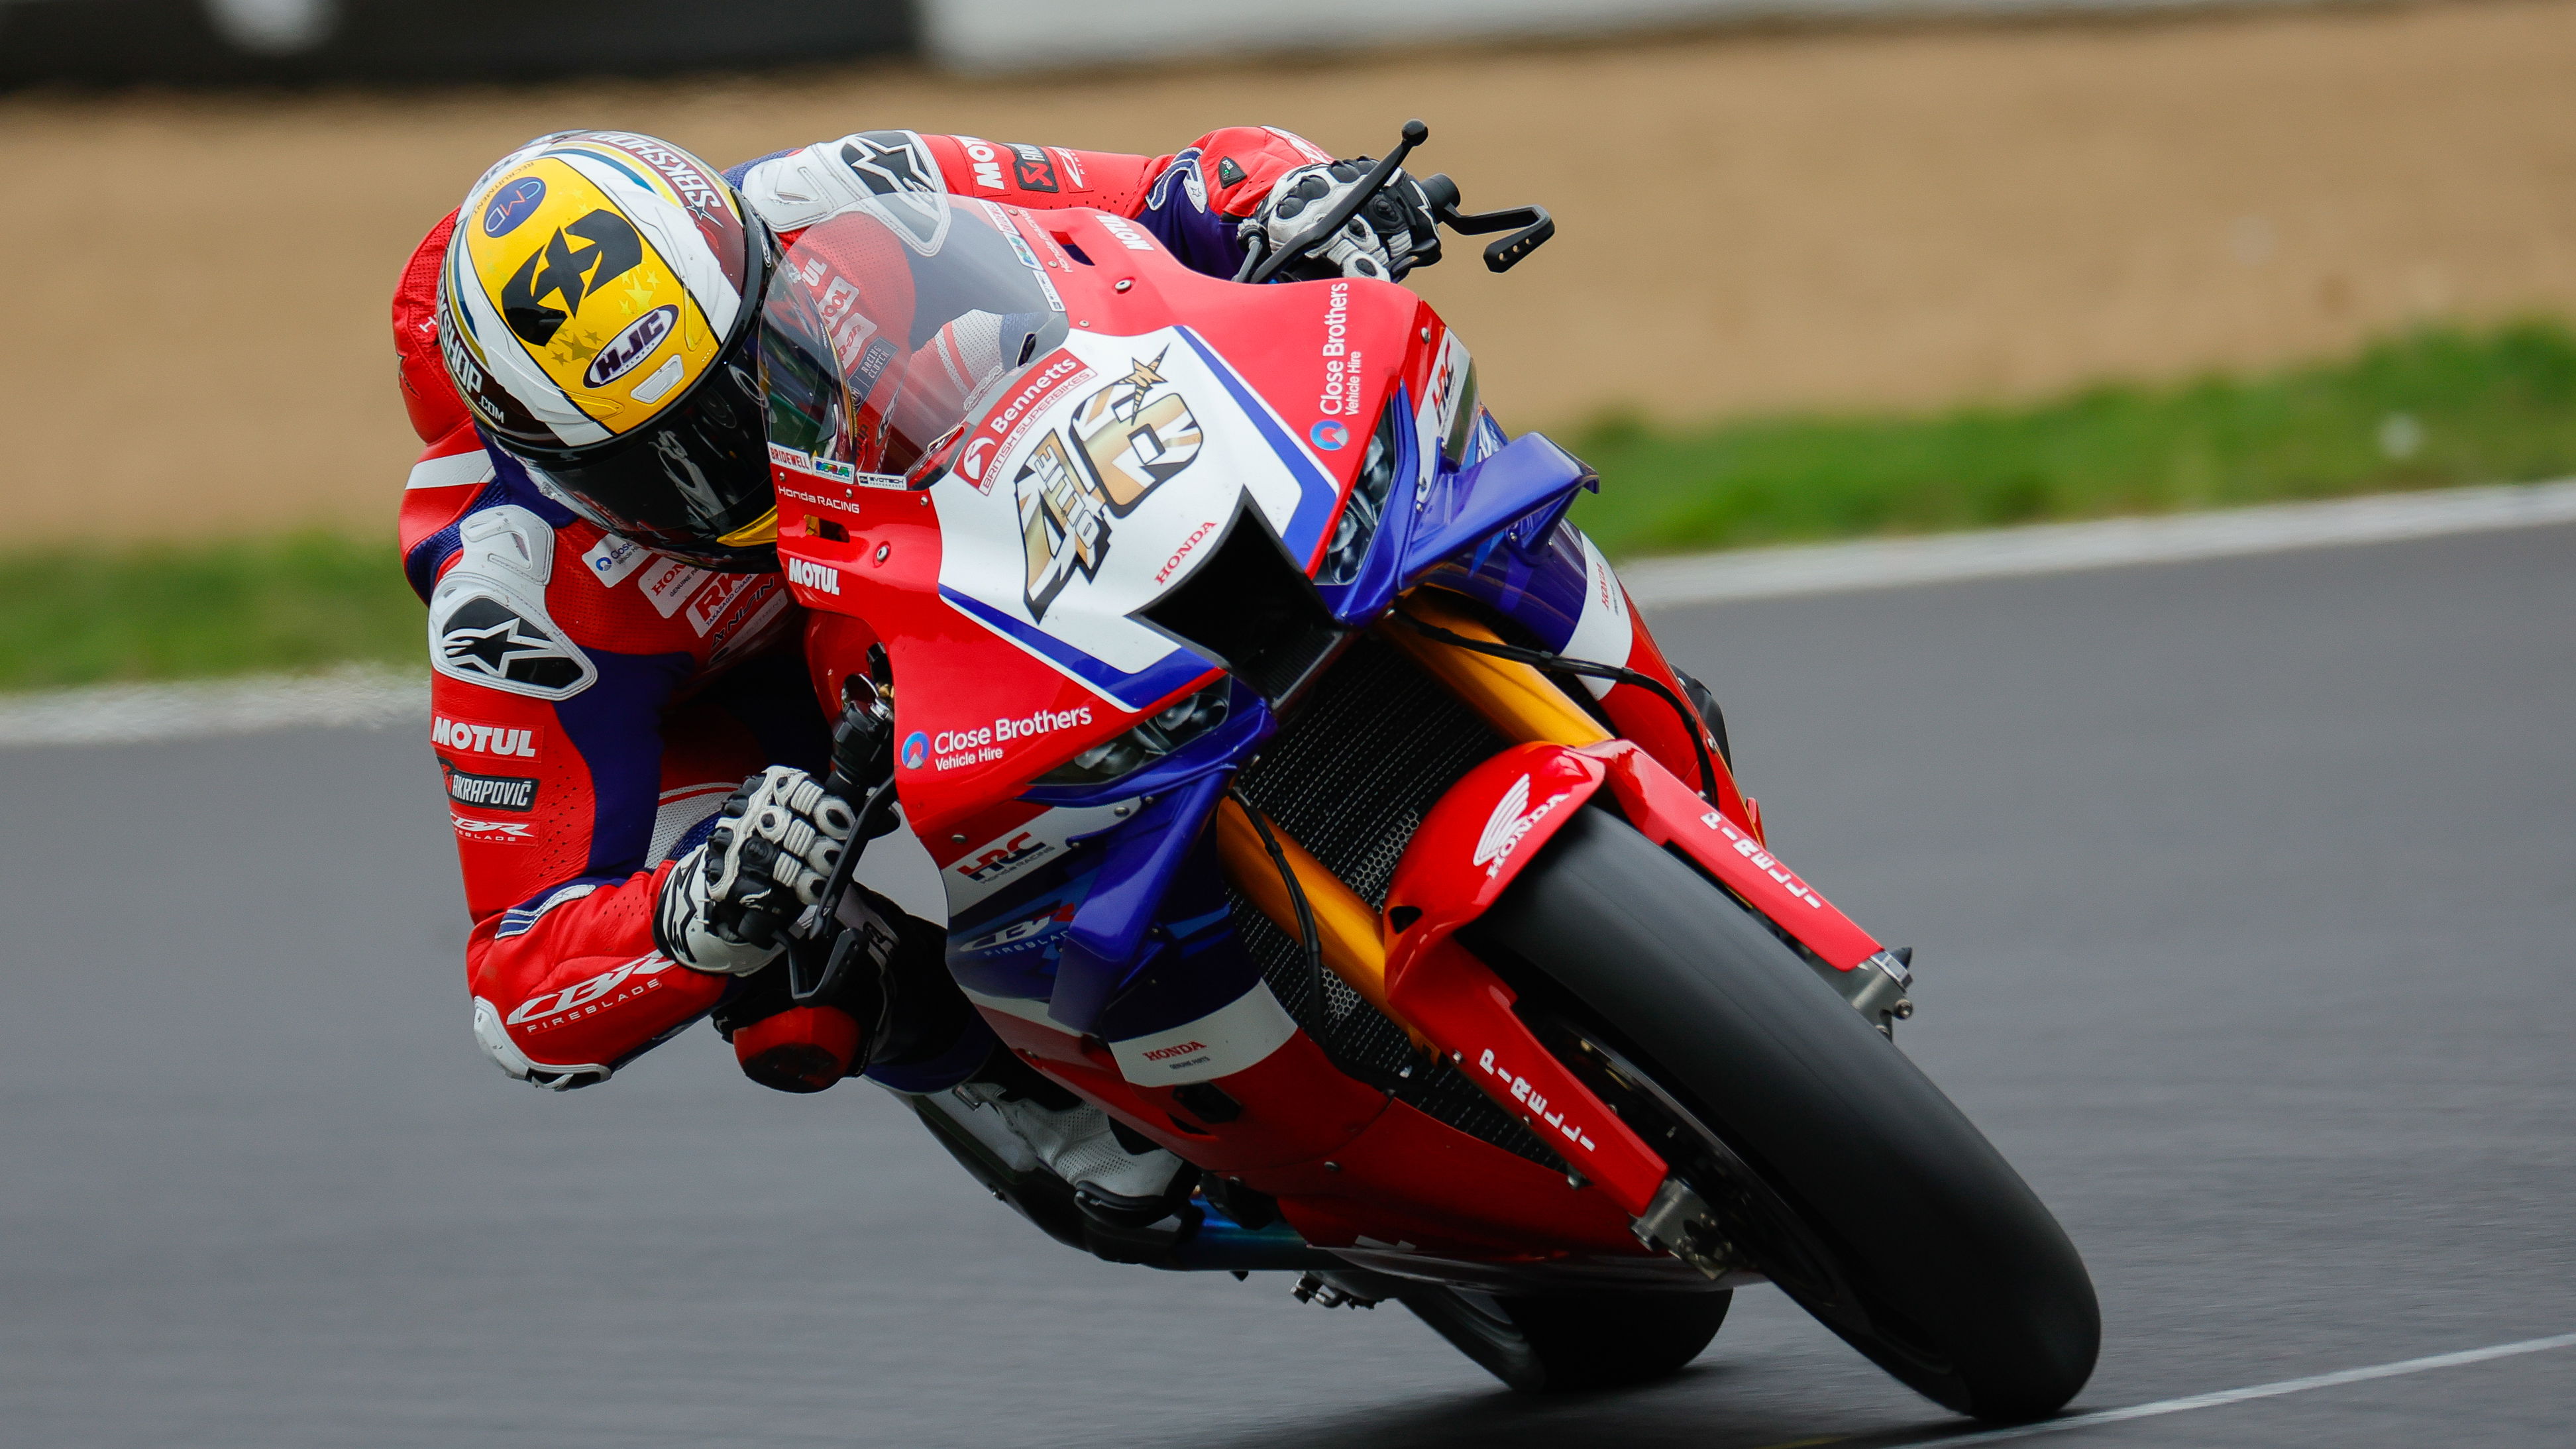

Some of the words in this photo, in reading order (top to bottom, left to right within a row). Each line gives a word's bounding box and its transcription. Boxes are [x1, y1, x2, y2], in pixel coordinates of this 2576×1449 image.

[590, 133, 722, 208] SBKSHOP
[486, 181, 542, 233] CMD
[1322, 282, 1348, 356] Brothers
[596, 309, 665, 384] HJC
[1350, 351, 1362, 373] Hire
[990, 356, 1078, 435] Bennetts
[1319, 360, 1344, 415] Close
[1345, 375, 1361, 415] Vehicle
[983, 435, 1018, 489] BRITISH
[1017, 372, 1091, 437] SUPERBIKES
[770, 447, 809, 470] BRIDEWELL
[778, 485, 816, 504] Honda
[817, 496, 860, 513] RACING
[1014, 379, 1203, 625] 46
[788, 557, 841, 596] MOTUL
[1155, 521, 1218, 585] HONDA
[651, 563, 686, 596] HON
[734, 575, 753, 596] CHAIN
[431, 716, 537, 757] MOTUL
[934, 727, 991, 755] Close
[995, 706, 1093, 742] Brothers
[935, 751, 976, 771] Vehicle
[979, 747, 1003, 763] Hire
[956, 832, 1047, 882] HRC
[1486, 793, 1570, 880] HONDA
[1701, 812, 1821, 909] PIRELLI
[984, 930, 1069, 956] FIREBLA
[506, 948, 676, 1026] CBR
[527, 978, 661, 1033] FIREBLADE
[1142, 1040, 1208, 1061] HONDA
[1479, 1048, 1595, 1153] PIRELLI
